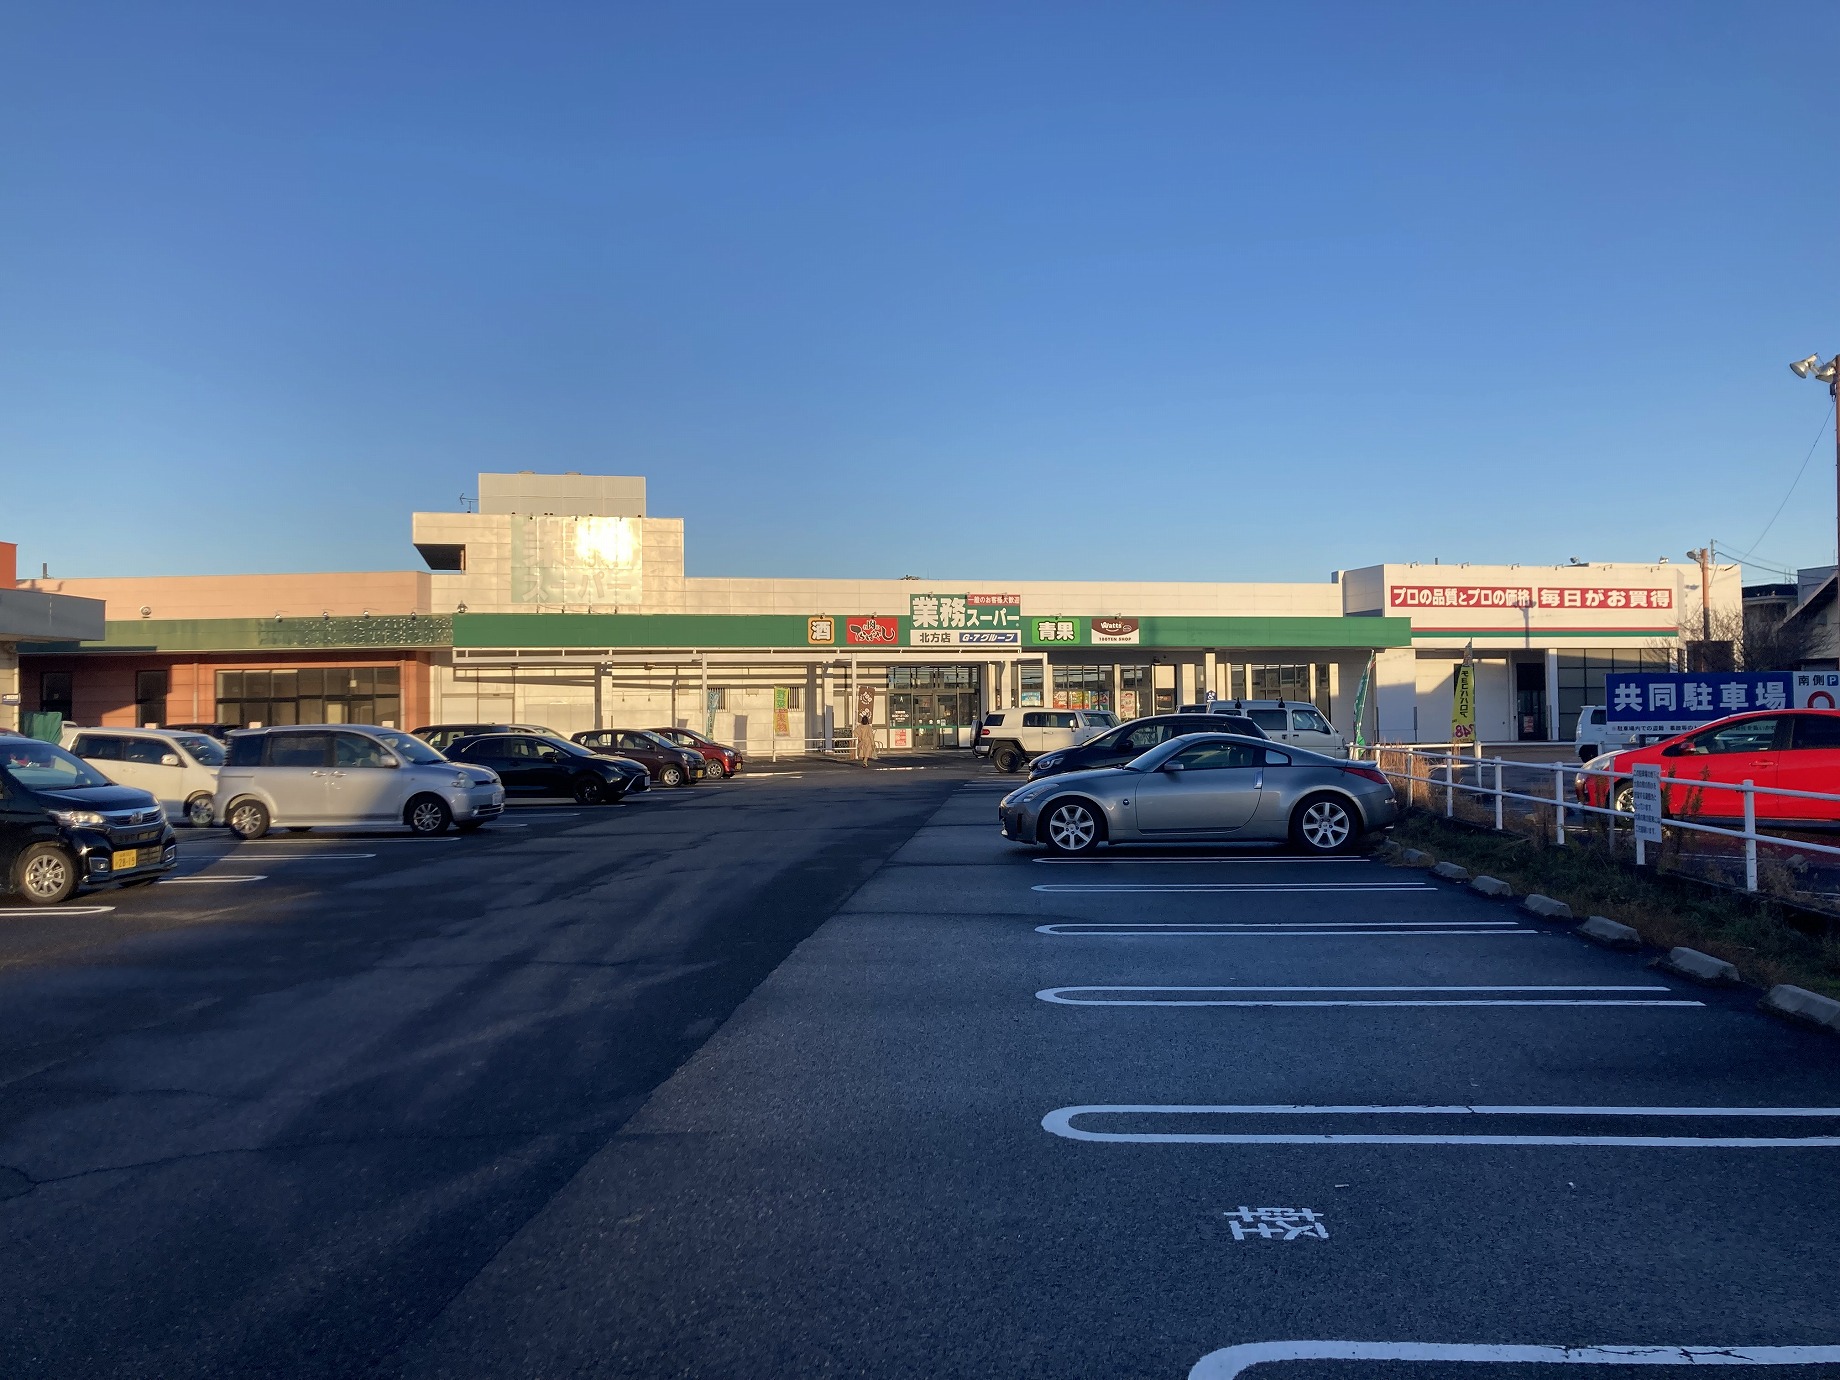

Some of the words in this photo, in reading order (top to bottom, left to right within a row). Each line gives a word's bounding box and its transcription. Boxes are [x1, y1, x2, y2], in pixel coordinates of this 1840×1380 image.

[523, 571, 631, 600] スーパー
[1393, 588, 1530, 607] プロの品質とプロの価格
[1540, 589, 1670, 608] 毎日がお買得
[912, 597, 1020, 627] 業務スーパー
[811, 621, 832, 641] 酒
[1038, 621, 1075, 641] 青果
[1100, 621, 1122, 630] Watts
[920, 632, 951, 644] 北方店
[1798, 675, 1825, 686] 南側
[1614, 681, 1787, 712] 共同駐車場
